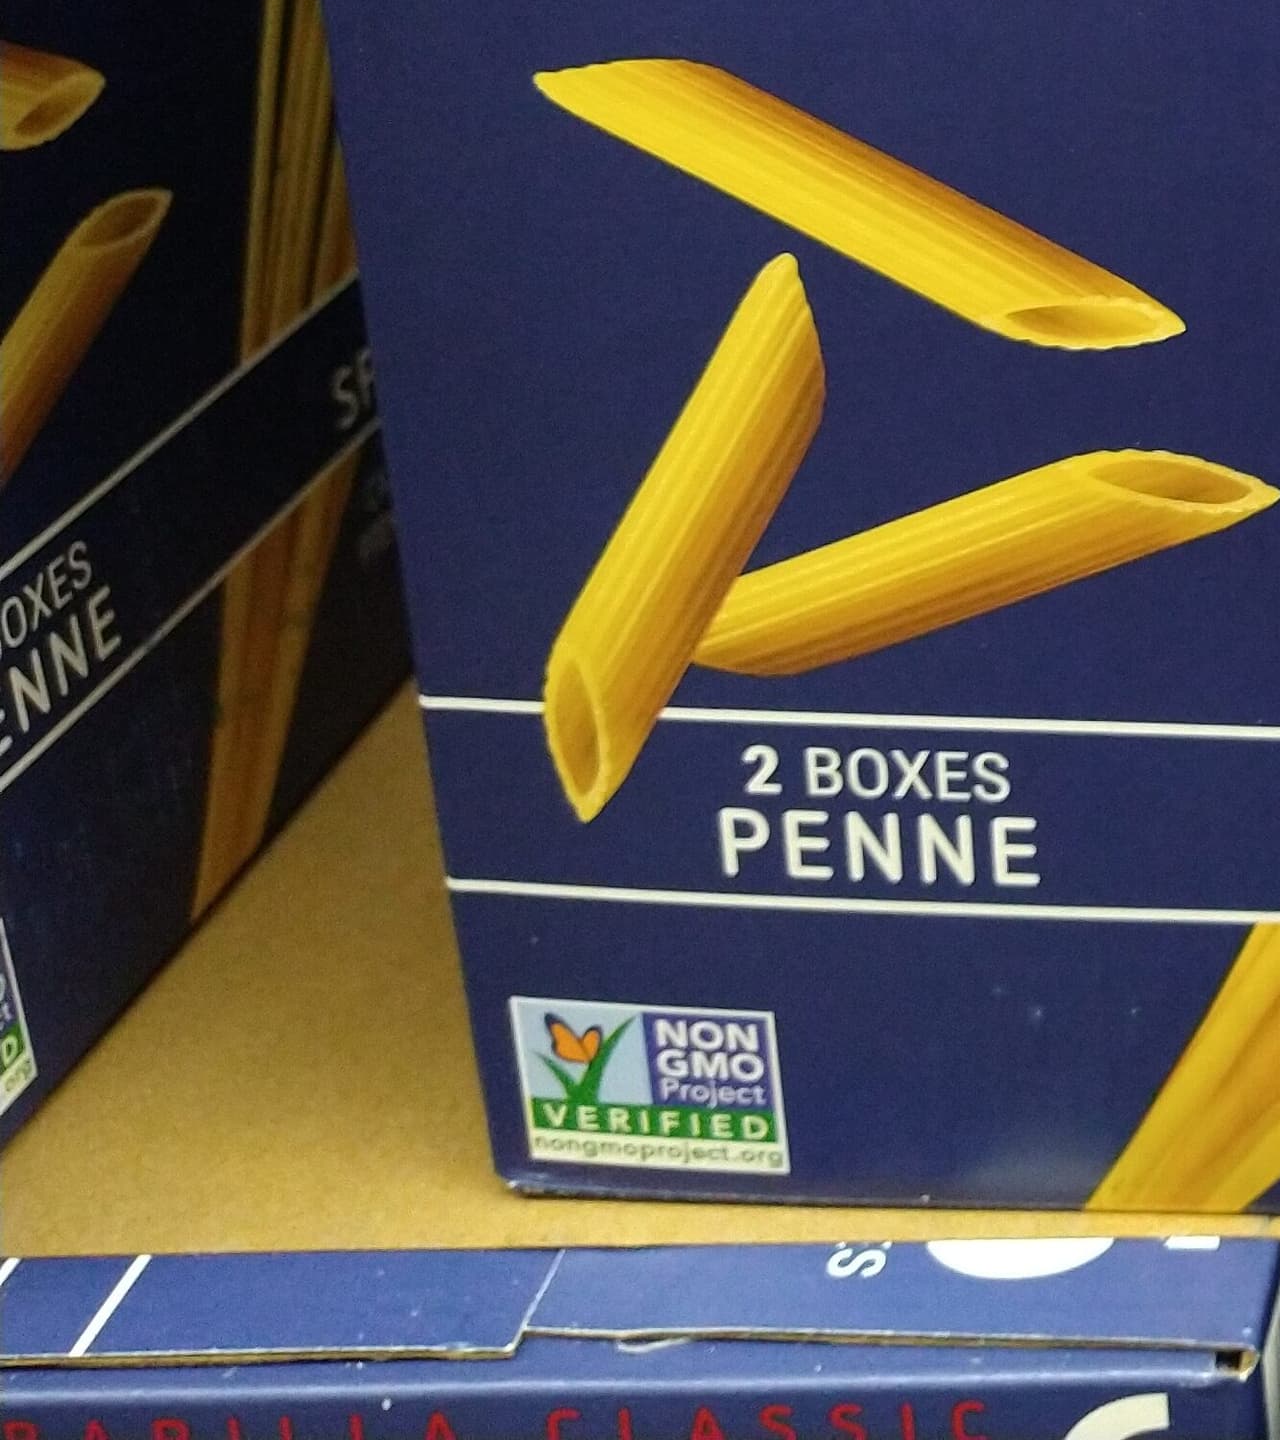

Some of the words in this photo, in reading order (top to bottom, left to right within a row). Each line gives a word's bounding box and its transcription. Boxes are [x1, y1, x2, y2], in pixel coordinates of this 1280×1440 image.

[0, 540, 92, 649] OXES
[741, 744, 783, 796] 2
[804, 746, 1011, 803] BOXES
[718, 806, 1041, 887] PENNE
[655, 1019, 760, 1053] NON
[657, 1048, 765, 1083] GMO
[661, 1077, 767, 1110] Project
[542, 1103, 769, 1141] VERIFIED
[534, 1135, 783, 1168] nongmoproject.org
